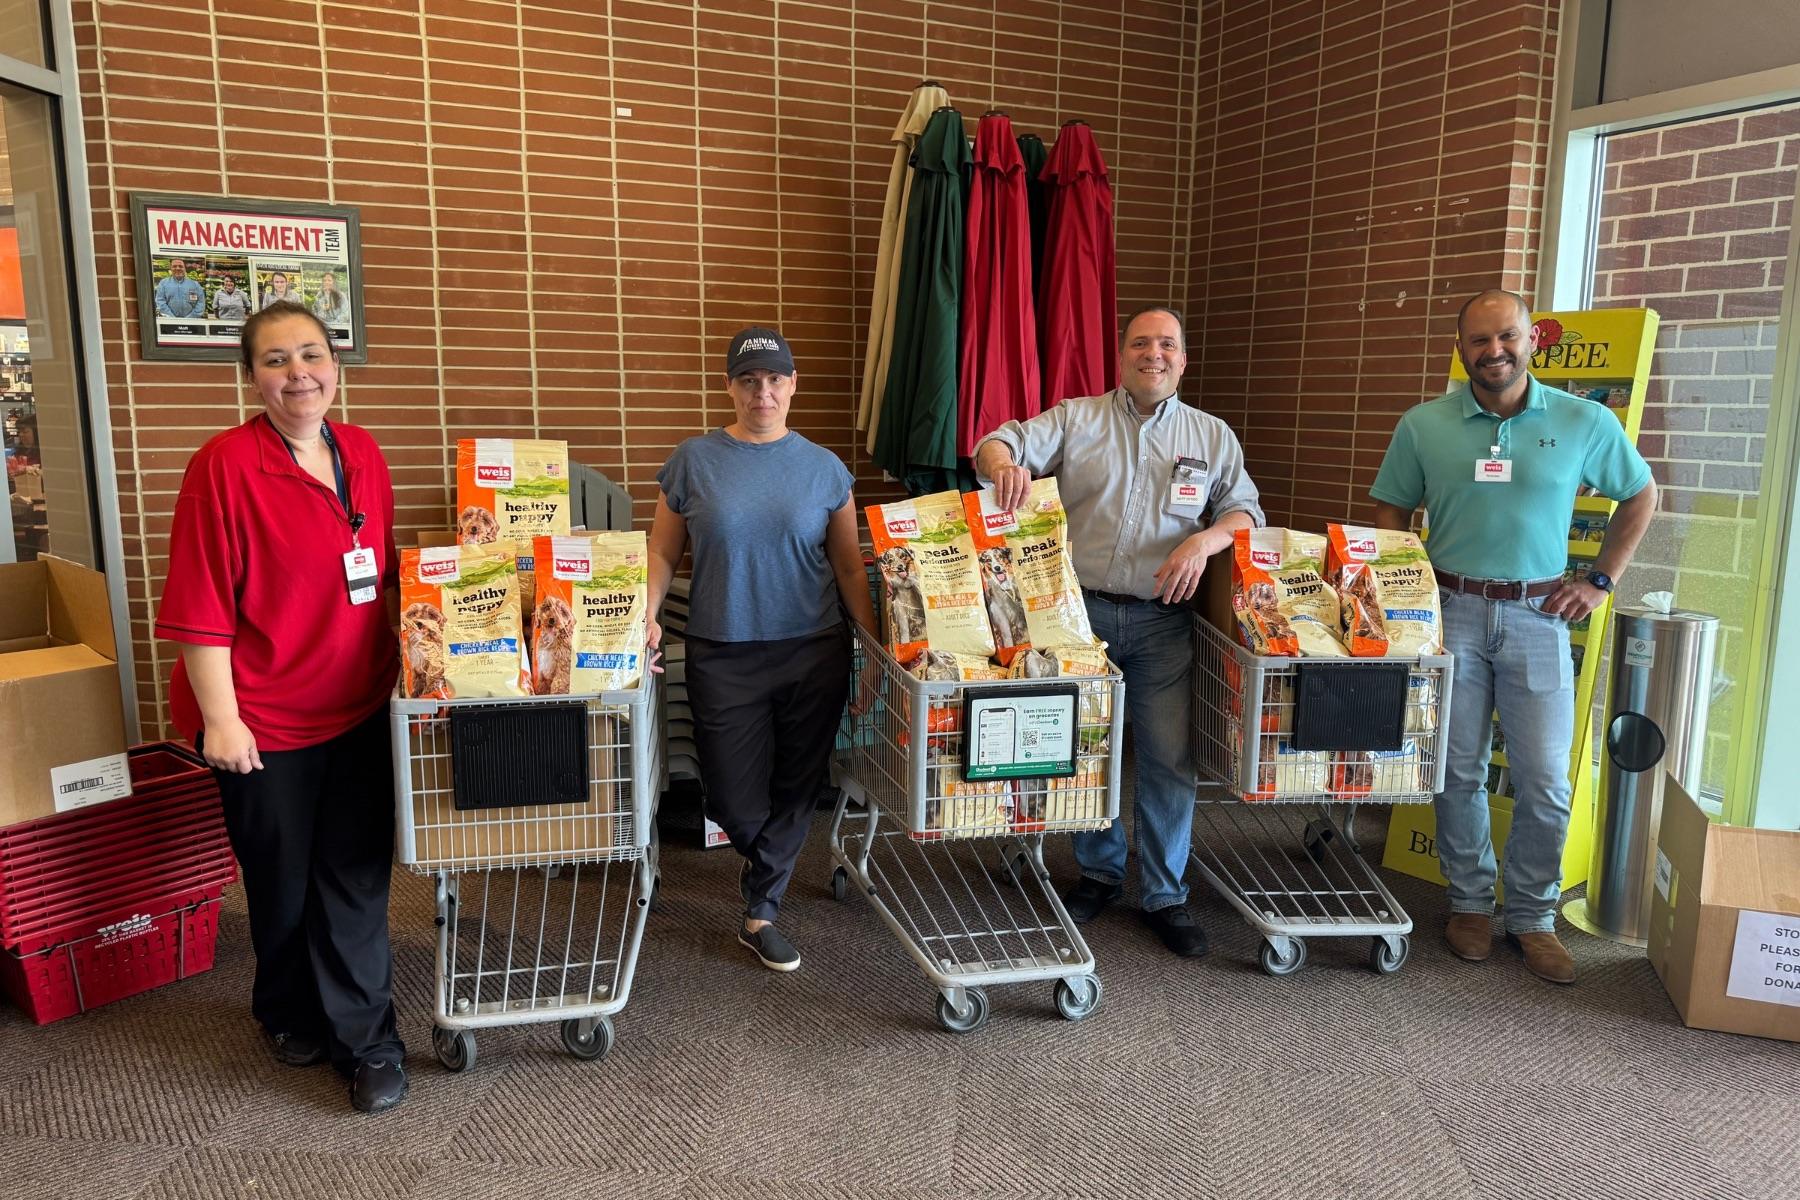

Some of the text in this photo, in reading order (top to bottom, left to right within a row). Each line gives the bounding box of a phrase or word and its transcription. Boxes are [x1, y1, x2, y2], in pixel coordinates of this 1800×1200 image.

[156, 219, 324, 252] MANAGEMENT
[325, 228, 340, 253] TEAM
[479, 467, 510, 477] weis
[986, 513, 1012, 525] weis
[889, 520, 915, 532] weis
[924, 546, 960, 560] peak
[1022, 538, 1057, 556] peak
[1254, 553, 1279, 563] weis
[421, 561, 455, 574] weis
[557, 560, 588, 570] weis
[1286, 584, 1324, 597] puppy
[582, 594, 636, 605] healthy
[586, 605, 632, 618] puppy
[97, 913, 152, 938] weis
[1760, 943, 1800, 957] PLEAS
